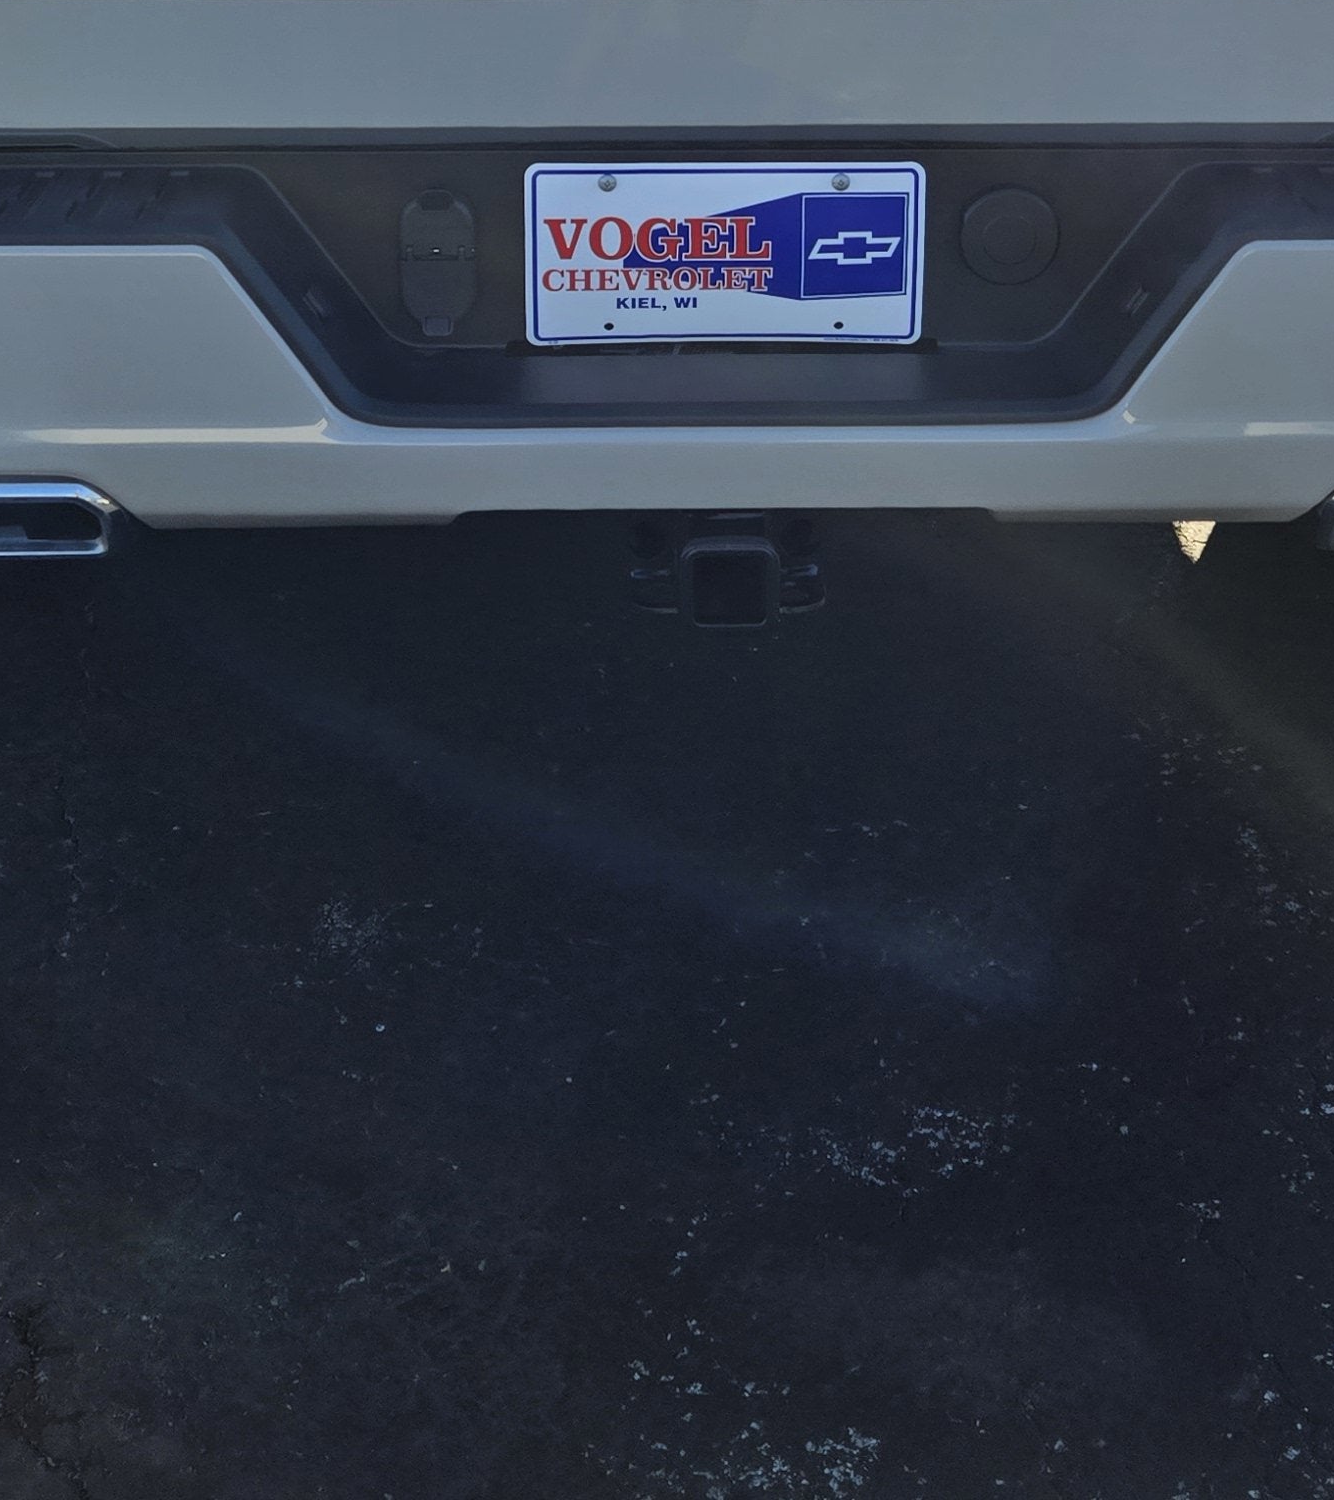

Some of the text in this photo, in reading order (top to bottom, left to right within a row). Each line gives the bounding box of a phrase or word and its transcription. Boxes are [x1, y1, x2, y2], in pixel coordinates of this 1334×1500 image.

[543, 216, 771, 261] VOGEL
[542, 267, 773, 292] CHEVROLET
[616, 297, 698, 311] KIEL, WI
